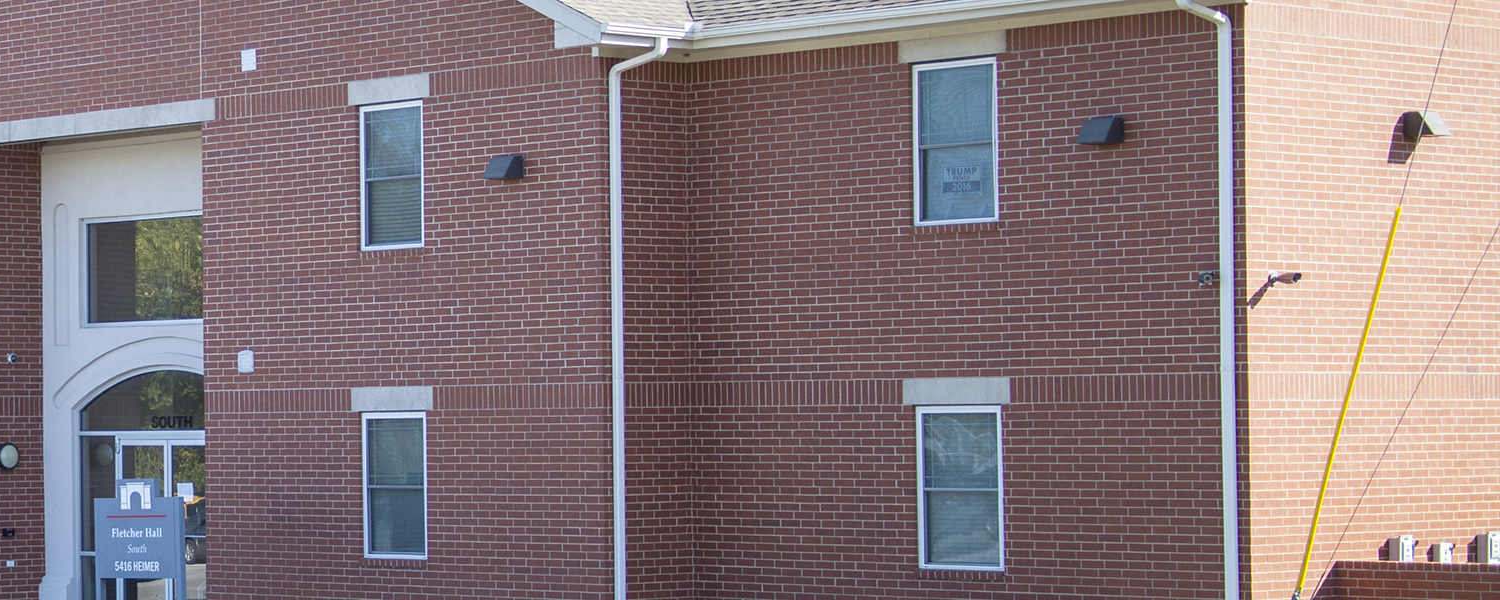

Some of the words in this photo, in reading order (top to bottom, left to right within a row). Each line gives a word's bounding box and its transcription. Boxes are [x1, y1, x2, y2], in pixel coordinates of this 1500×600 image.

[946, 166, 977, 176] TRUMP
[952, 182, 972, 191] 2016
[151, 415, 193, 428] SOUTH
[111, 527, 144, 538] Fletcher
[145, 527, 163, 538] Hall
[127, 543, 147, 554] South
[114, 560, 133, 572] 5416
[133, 561, 160, 572] HEIMER
